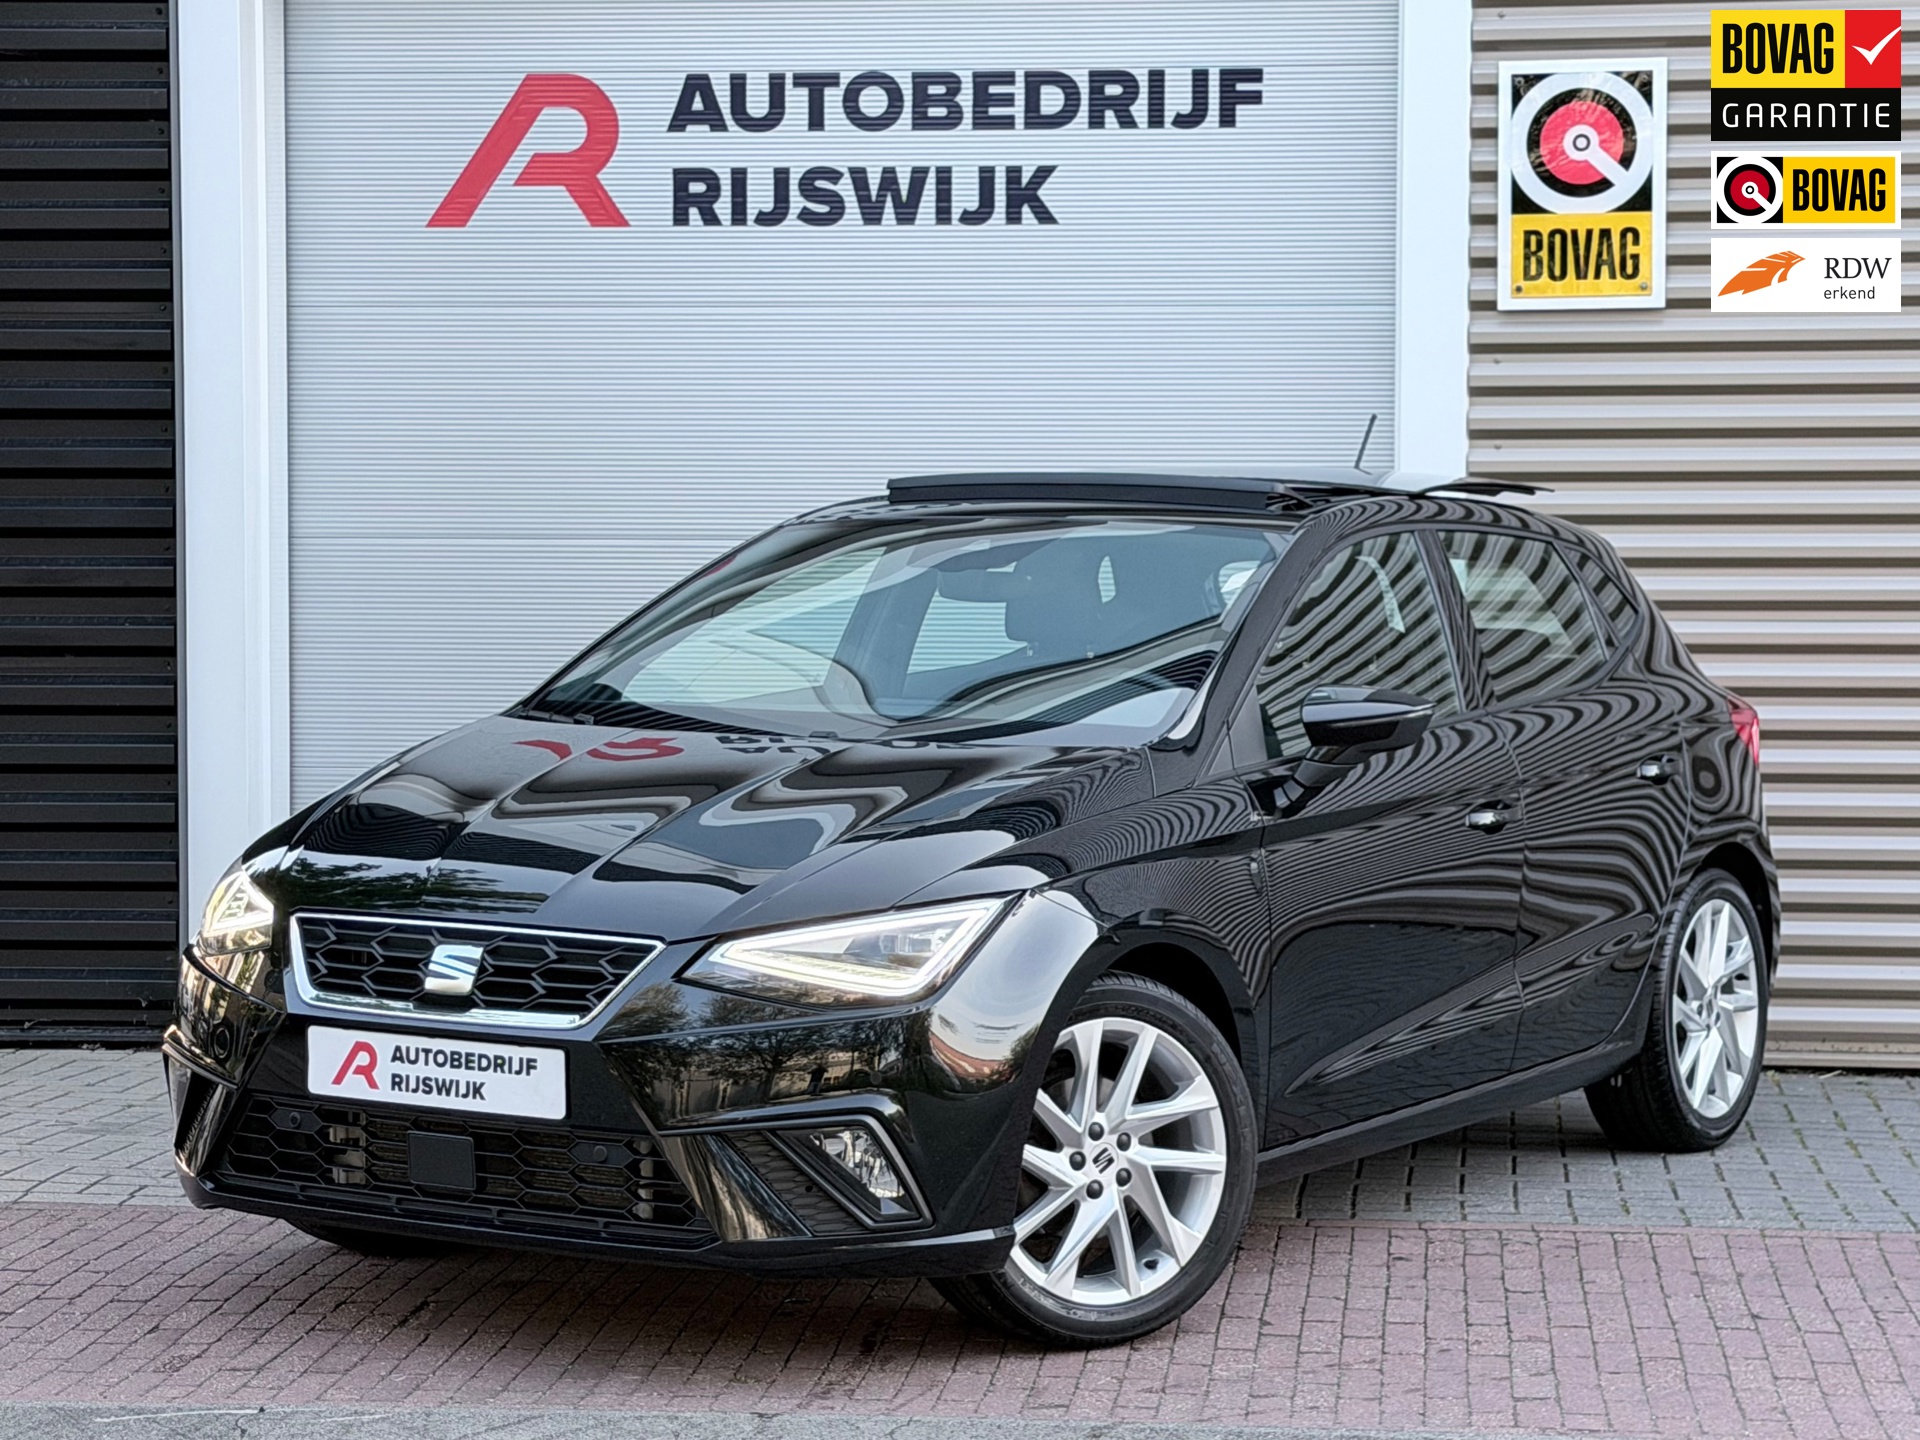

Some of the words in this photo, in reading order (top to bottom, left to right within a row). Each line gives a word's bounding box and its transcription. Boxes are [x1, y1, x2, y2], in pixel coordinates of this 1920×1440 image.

[667, 68, 1264, 133] AUTOBEDRIJF
[672, 165, 1058, 227] RIJSWIJK
[1522, 226, 1641, 282] BOVAG
[390, 1045, 538, 1077] AUTOBEDRIJF
[390, 1073, 486, 1101] RIJSWIJK
